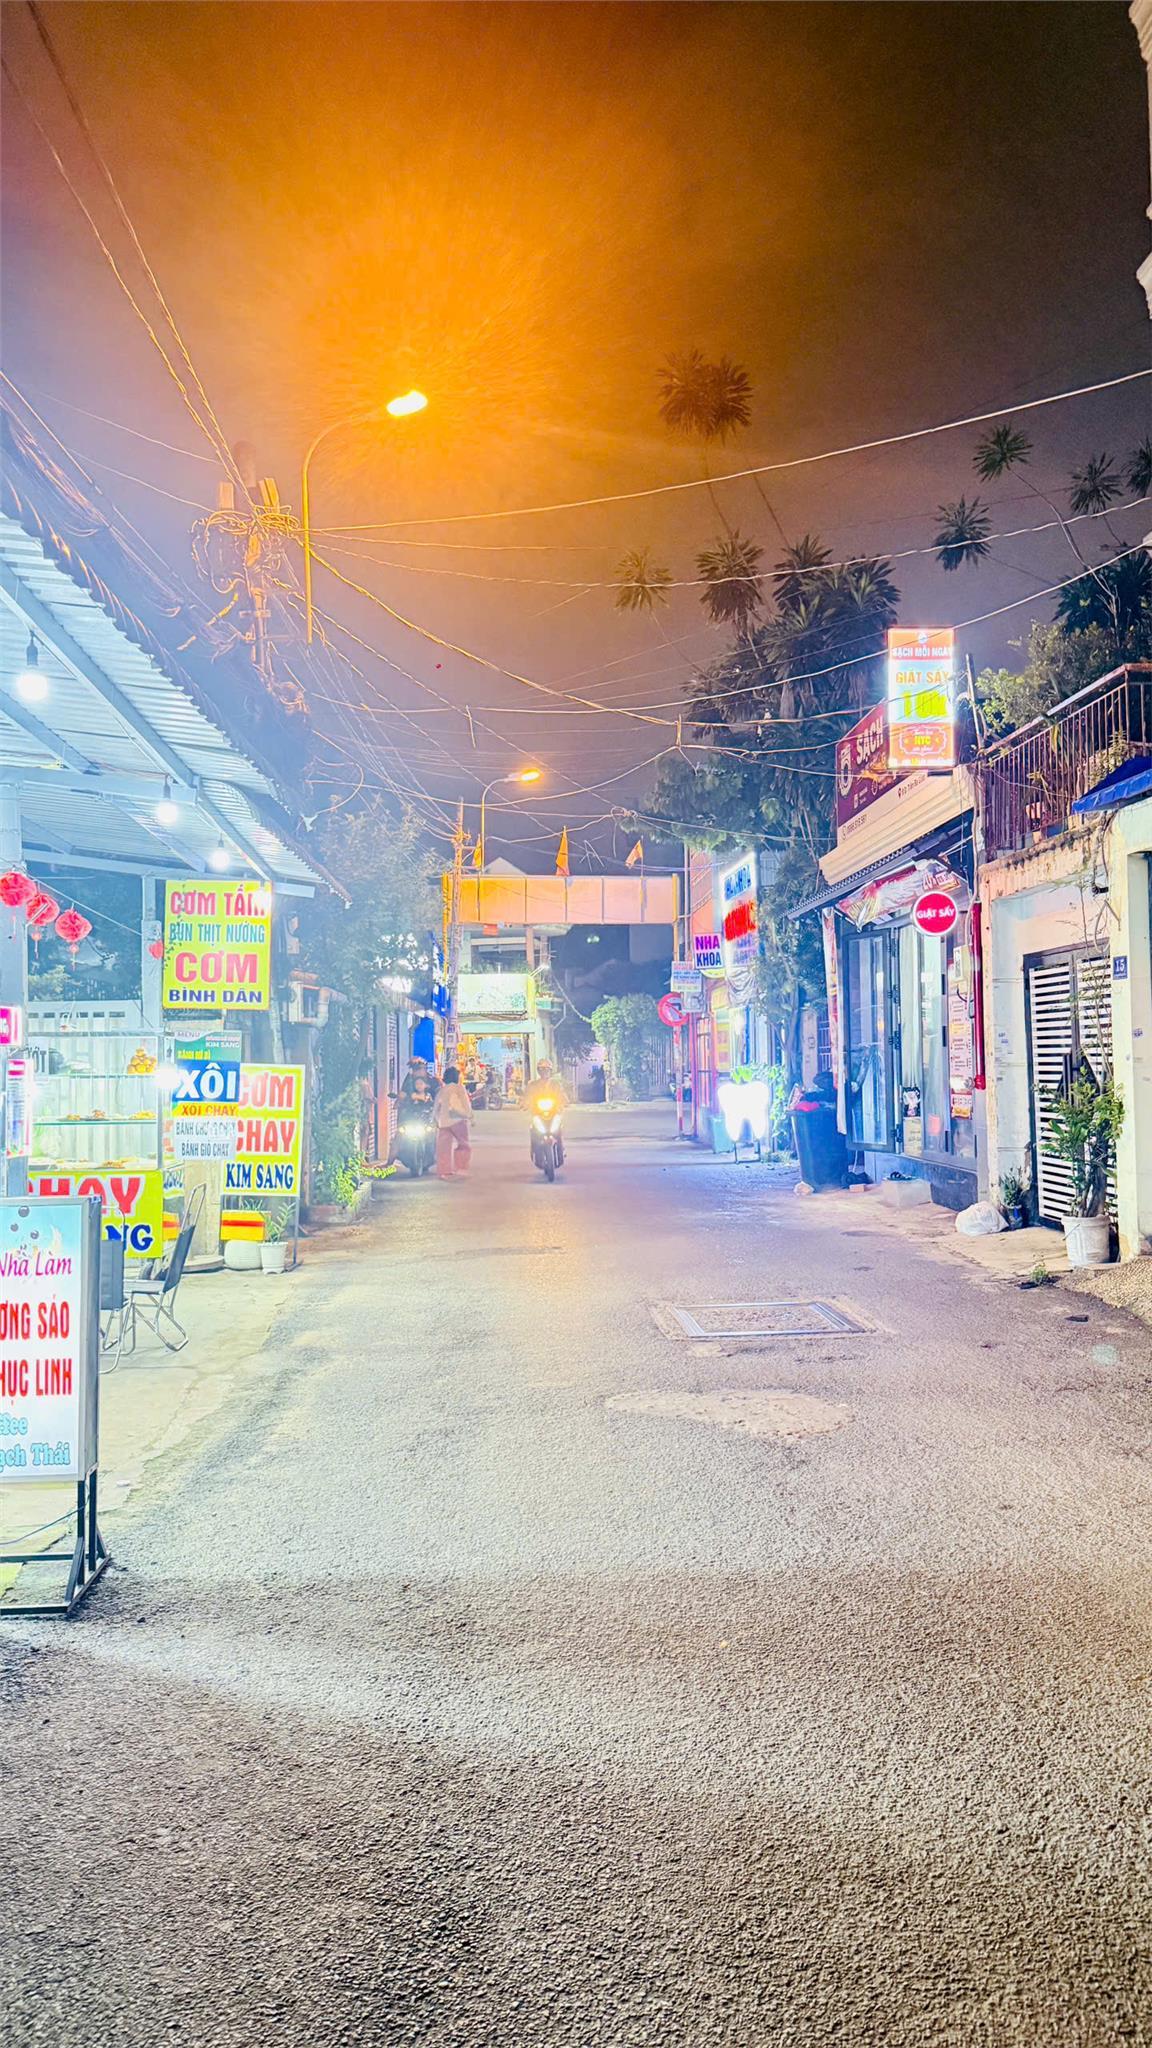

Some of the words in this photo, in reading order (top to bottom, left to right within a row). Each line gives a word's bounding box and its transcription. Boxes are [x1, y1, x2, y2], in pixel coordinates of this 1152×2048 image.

[896, 668, 922, 687] GIẶT
[856, 715, 884, 766] SẠCH
[171, 889, 217, 916] CƠM
[917, 907, 936, 920] GIẶT
[939, 904, 955, 918] SẤY
[198, 923, 221, 947] THỊT
[226, 920, 265, 943] NƯỚNG
[695, 935, 720, 951] NHA
[176, 950, 258, 984] CƠM
[696, 951, 722, 967] KHOA
[1115, 959, 1125, 973] 15
[169, 986, 216, 1002] BÌNH
[223, 987, 262, 1003] DÂN
[176, 1062, 237, 1099] XÔI
[205, 1103, 236, 1117] CHAY
[176, 1120, 193, 1136] BÁNH
[181, 1140, 198, 1157] BÁNH
[213, 1142, 229, 1157] CHAY
[225, 1163, 251, 1189] KIM
[256, 1163, 294, 1190] SANG
[28, 1177, 141, 1214] HAY
[35, 1250, 72, 1276] Làm
[38, 1293, 70, 1340] SÁO
[36, 1358, 73, 1396] LINH
[31, 1441, 71, 1467] Thái
